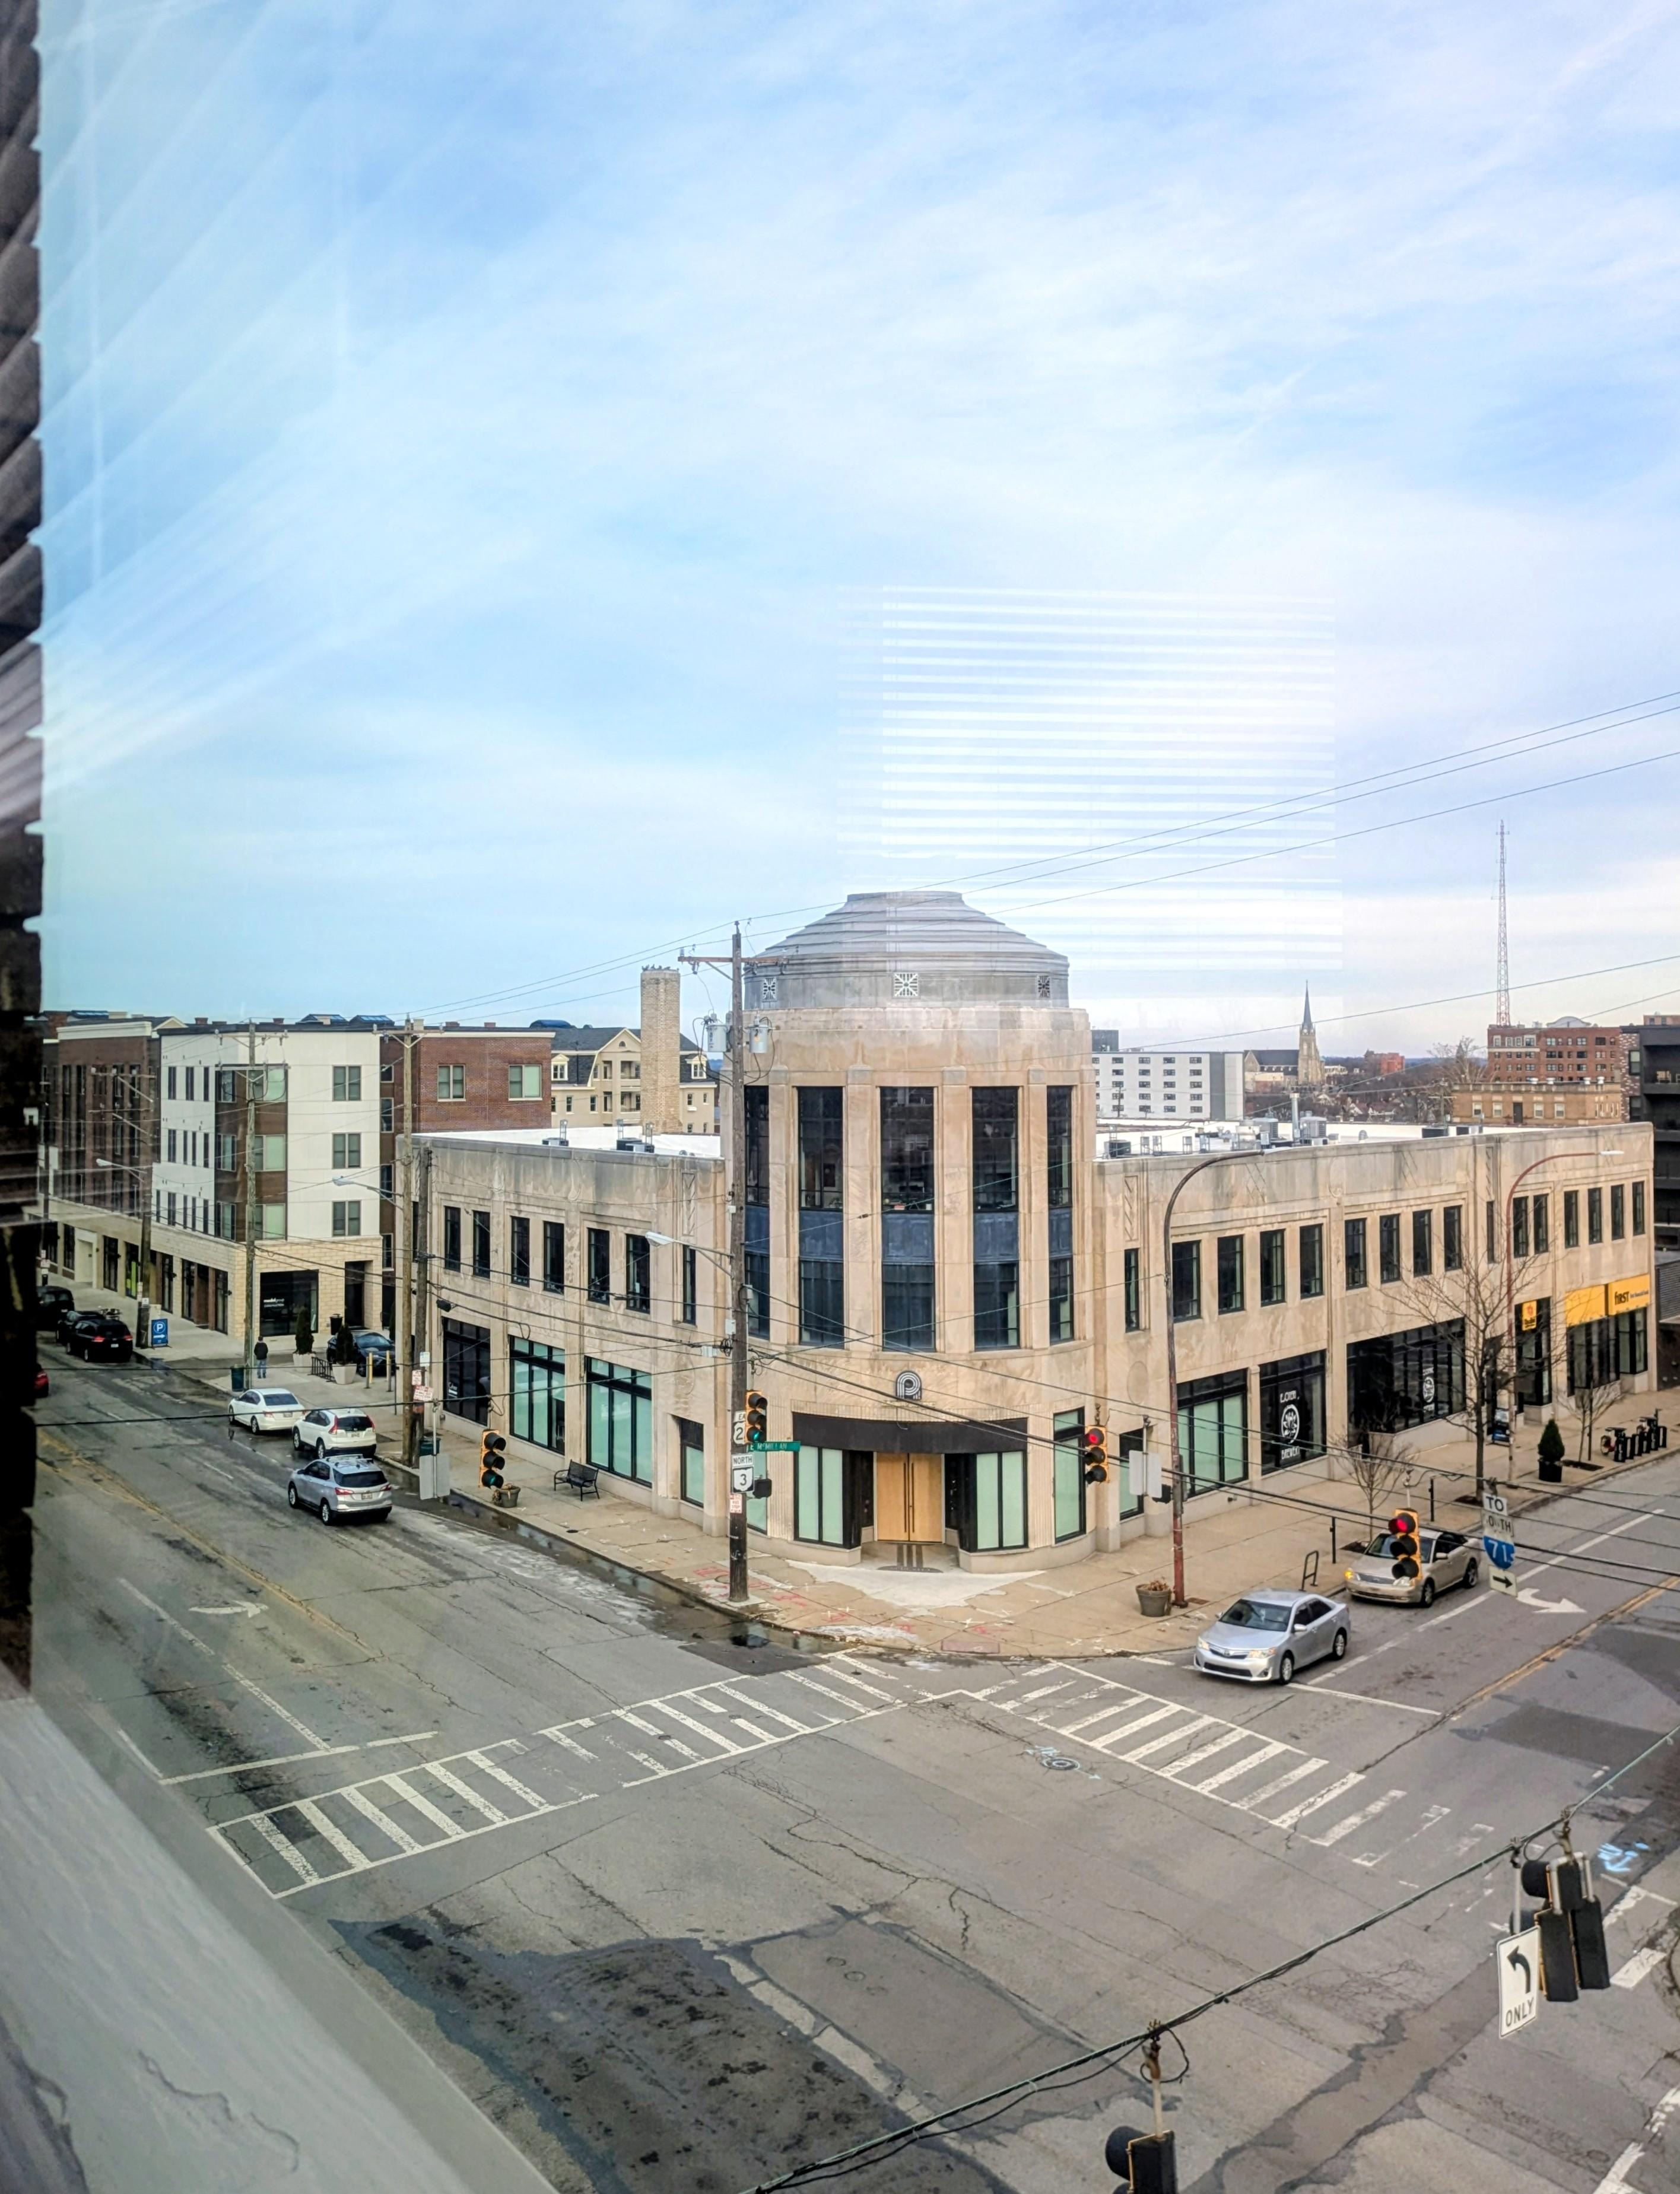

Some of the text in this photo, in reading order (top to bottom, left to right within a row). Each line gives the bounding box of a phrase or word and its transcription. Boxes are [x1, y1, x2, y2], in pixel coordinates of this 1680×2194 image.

[157, 1323, 163, 1332] P
[733, 1456, 752, 1465] NORTH
[739, 1474, 747, 1486] 3
[1486, 1496, 1504, 1512] TO
[1488, 1539, 1507, 1563] 71
[1506, 1997, 1534, 2027] ONLY
